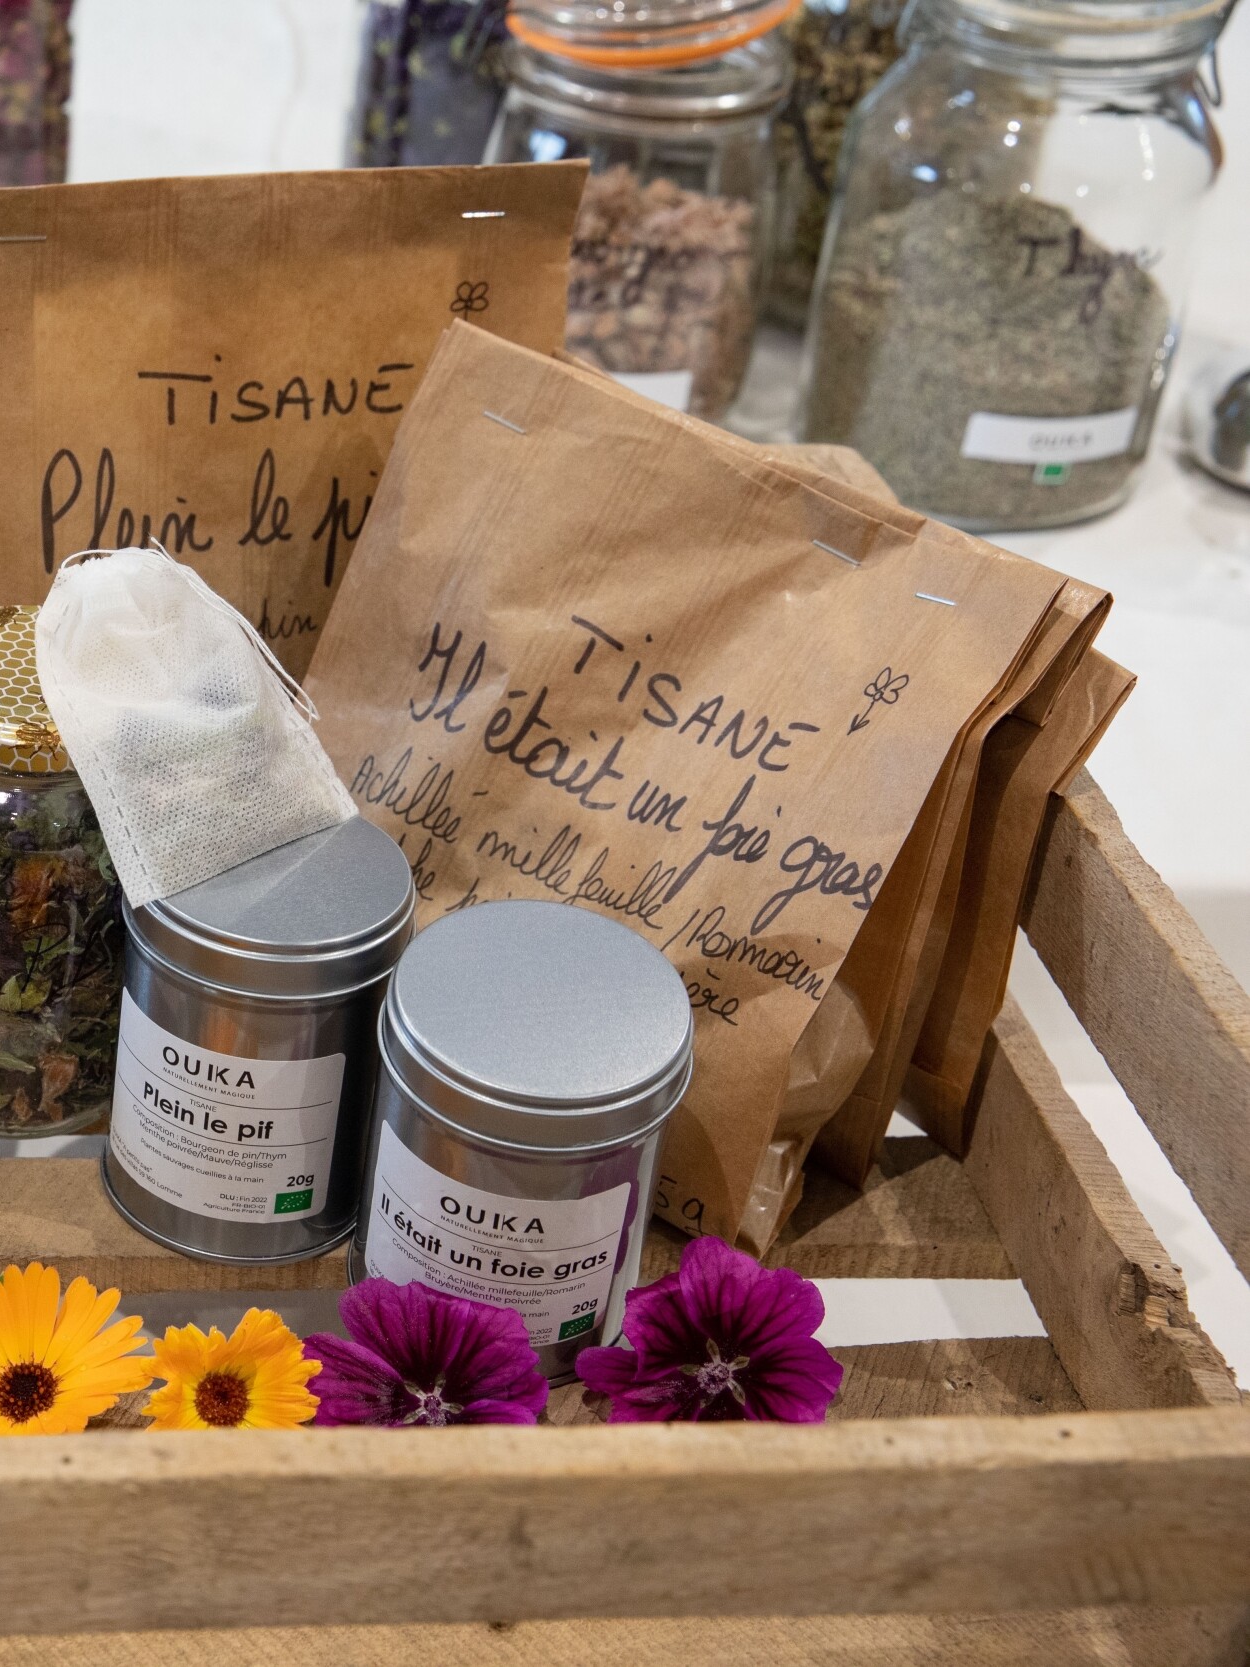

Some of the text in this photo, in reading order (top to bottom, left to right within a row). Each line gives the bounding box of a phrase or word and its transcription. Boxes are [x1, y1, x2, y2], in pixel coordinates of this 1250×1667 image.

[238, 448, 291, 546] le
[483, 687, 626, 811] était
[626, 780, 688, 833] un
[750, 835, 883, 936] gras
[162, 1046, 256, 1090] OUIKA
[162, 1066, 256, 1100] NATURELLEMENT MAGIQUE
[143, 1081, 275, 1142] Plein le pif
[190, 1098, 218, 1113] TISANE
[139, 1119, 166, 1143] Menthe
[180, 1135, 225, 1155] Bourgeon
[227, 1149, 240, 1158] de
[140, 1137, 163, 1157] Plantes
[162, 1153, 195, 1172] sauvages
[195, 1167, 227, 1180] cueillies
[243, 1176, 264, 1184] main
[286, 1174, 315, 1188] 20g
[440, 1196, 545, 1235] OUIKA
[440, 1215, 544, 1244] NATURELLEMENT MAGIQUE
[381, 1192, 608, 1280] Il était un foie gras
[472, 1244, 503, 1258] TISANE
[392, 1238, 442, 1276] Composition
[447, 1275, 486, 1292] Achillée
[571, 1298, 599, 1315] 20g
